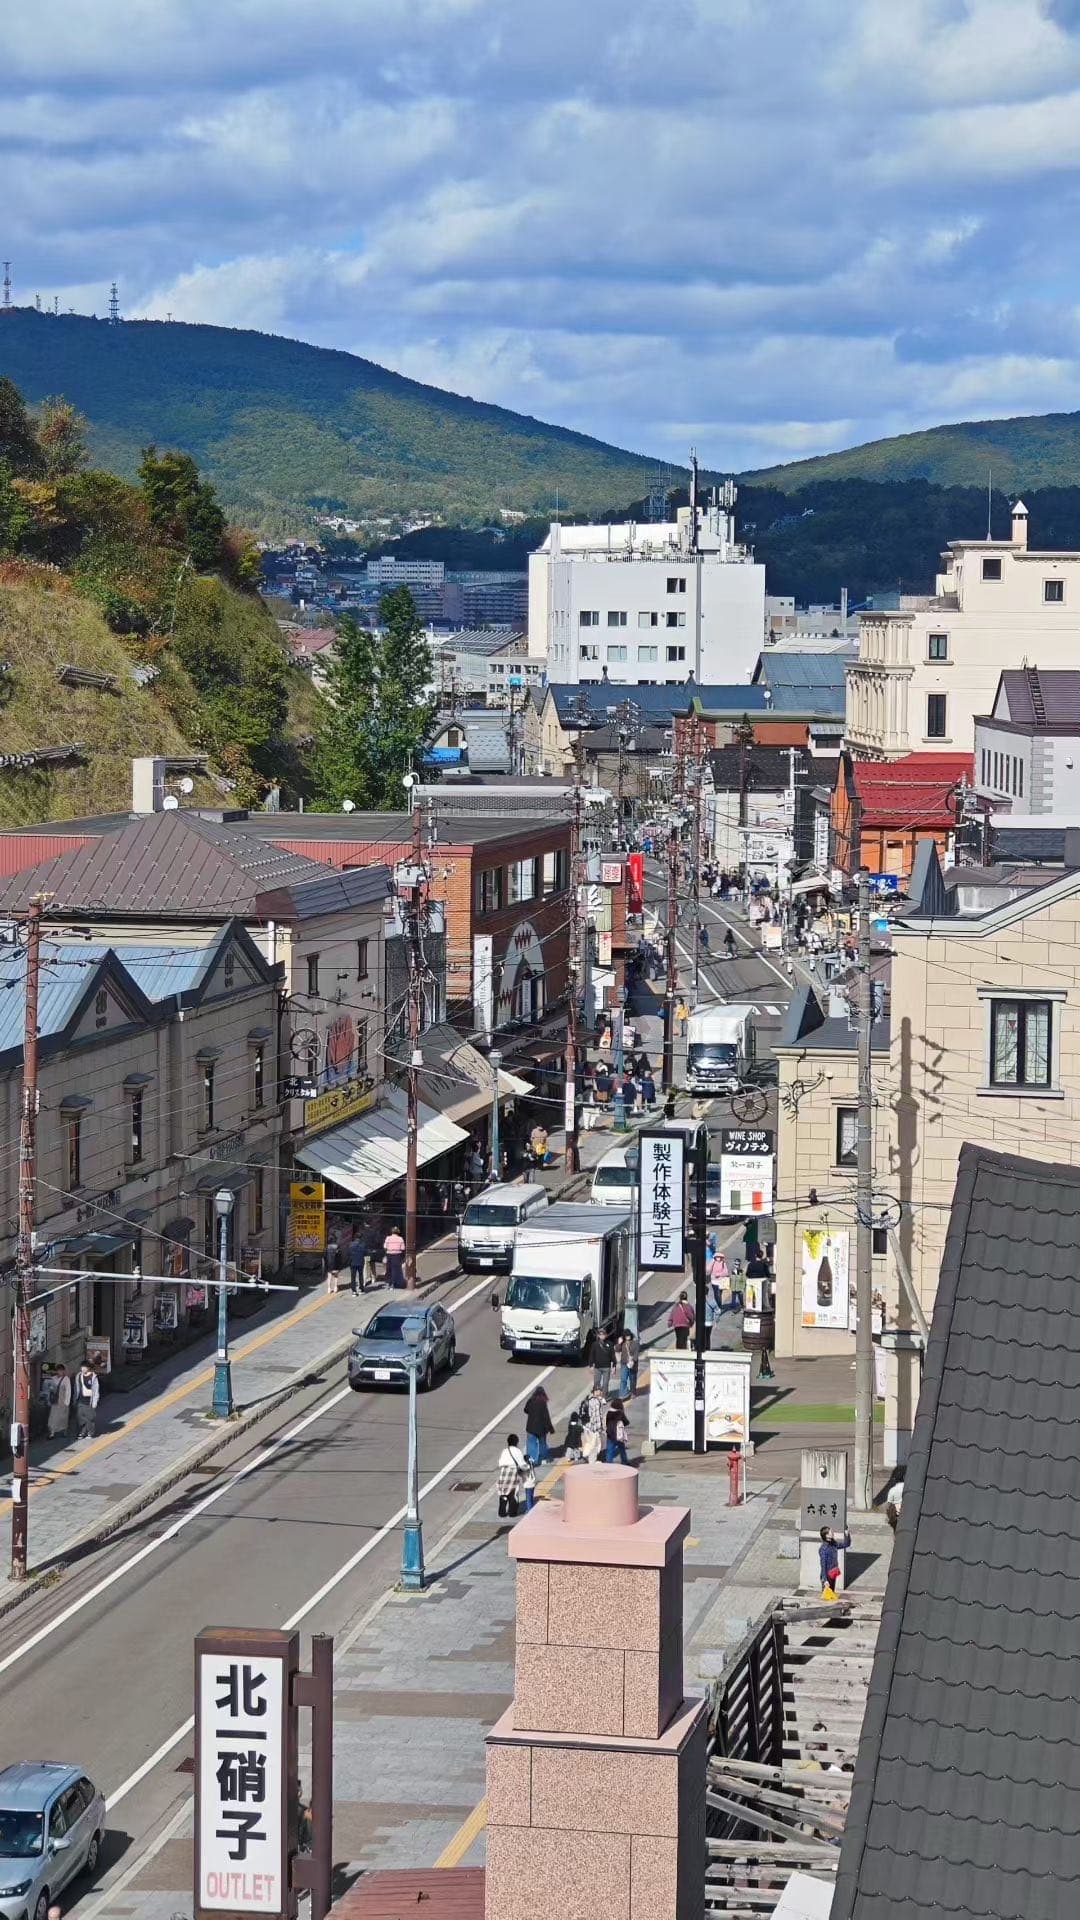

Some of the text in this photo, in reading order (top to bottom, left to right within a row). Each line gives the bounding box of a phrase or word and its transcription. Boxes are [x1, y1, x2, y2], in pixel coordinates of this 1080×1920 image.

[725, 1141, 770, 1152] ヴィノテカ
[729, 1131, 766, 1142] WINE SHOP
[652, 1143, 672, 1260] 製作体験工房
[214, 1663, 268, 1862] 北一硝子
[206, 1871, 275, 1902] OUTLET
